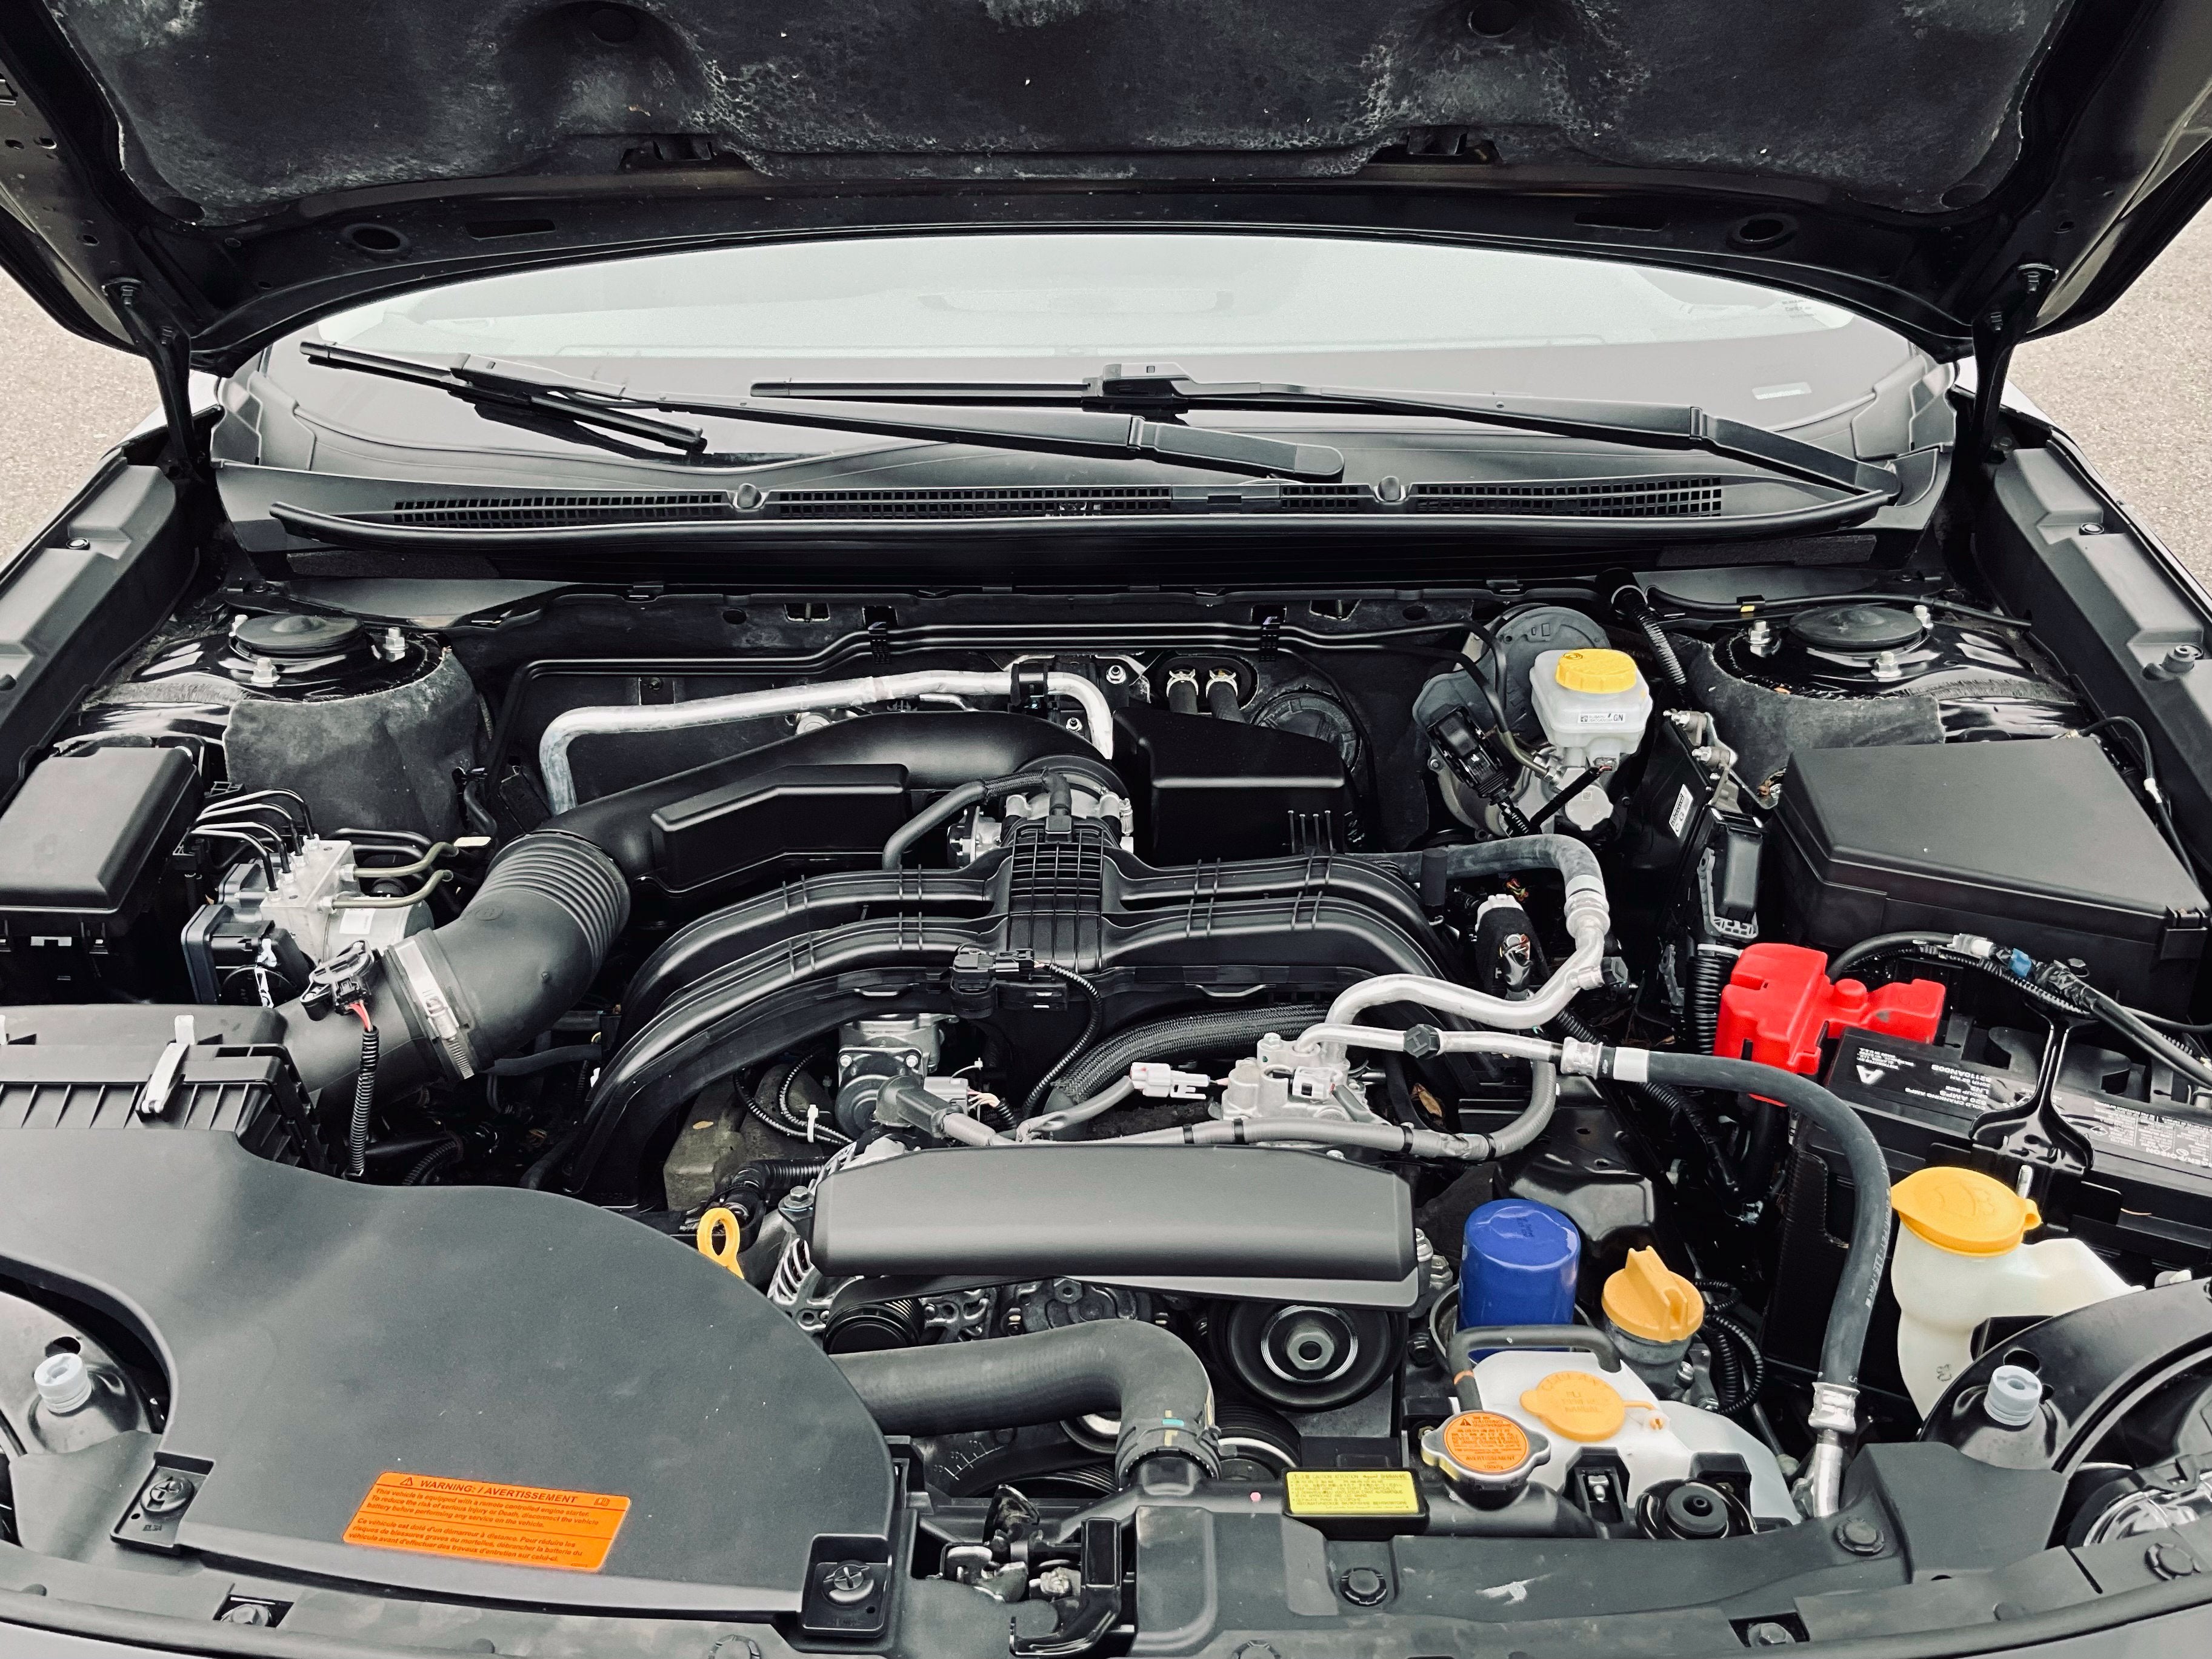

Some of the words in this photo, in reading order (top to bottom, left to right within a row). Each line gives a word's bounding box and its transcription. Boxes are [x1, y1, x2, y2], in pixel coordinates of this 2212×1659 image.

[1905, 1088, 1926, 1096] AMPS
[1939, 1090, 1968, 1101] AMPS
[1962, 1090, 1988, 1100] GROUP
[1927, 1093, 1965, 1105] CRANKING
[1965, 1102, 1986, 1111] COLD
[420, 1480, 476, 1492] WARNING:
[484, 1488, 578, 1503] AVERTISSEMENT
[366, 1502, 391, 1511] battery
[414, 1509, 453, 1518] performing
[468, 1514, 494, 1522] service
[521, 1513, 561, 1521] disconnect
[390, 1530, 424, 1538] blessures
